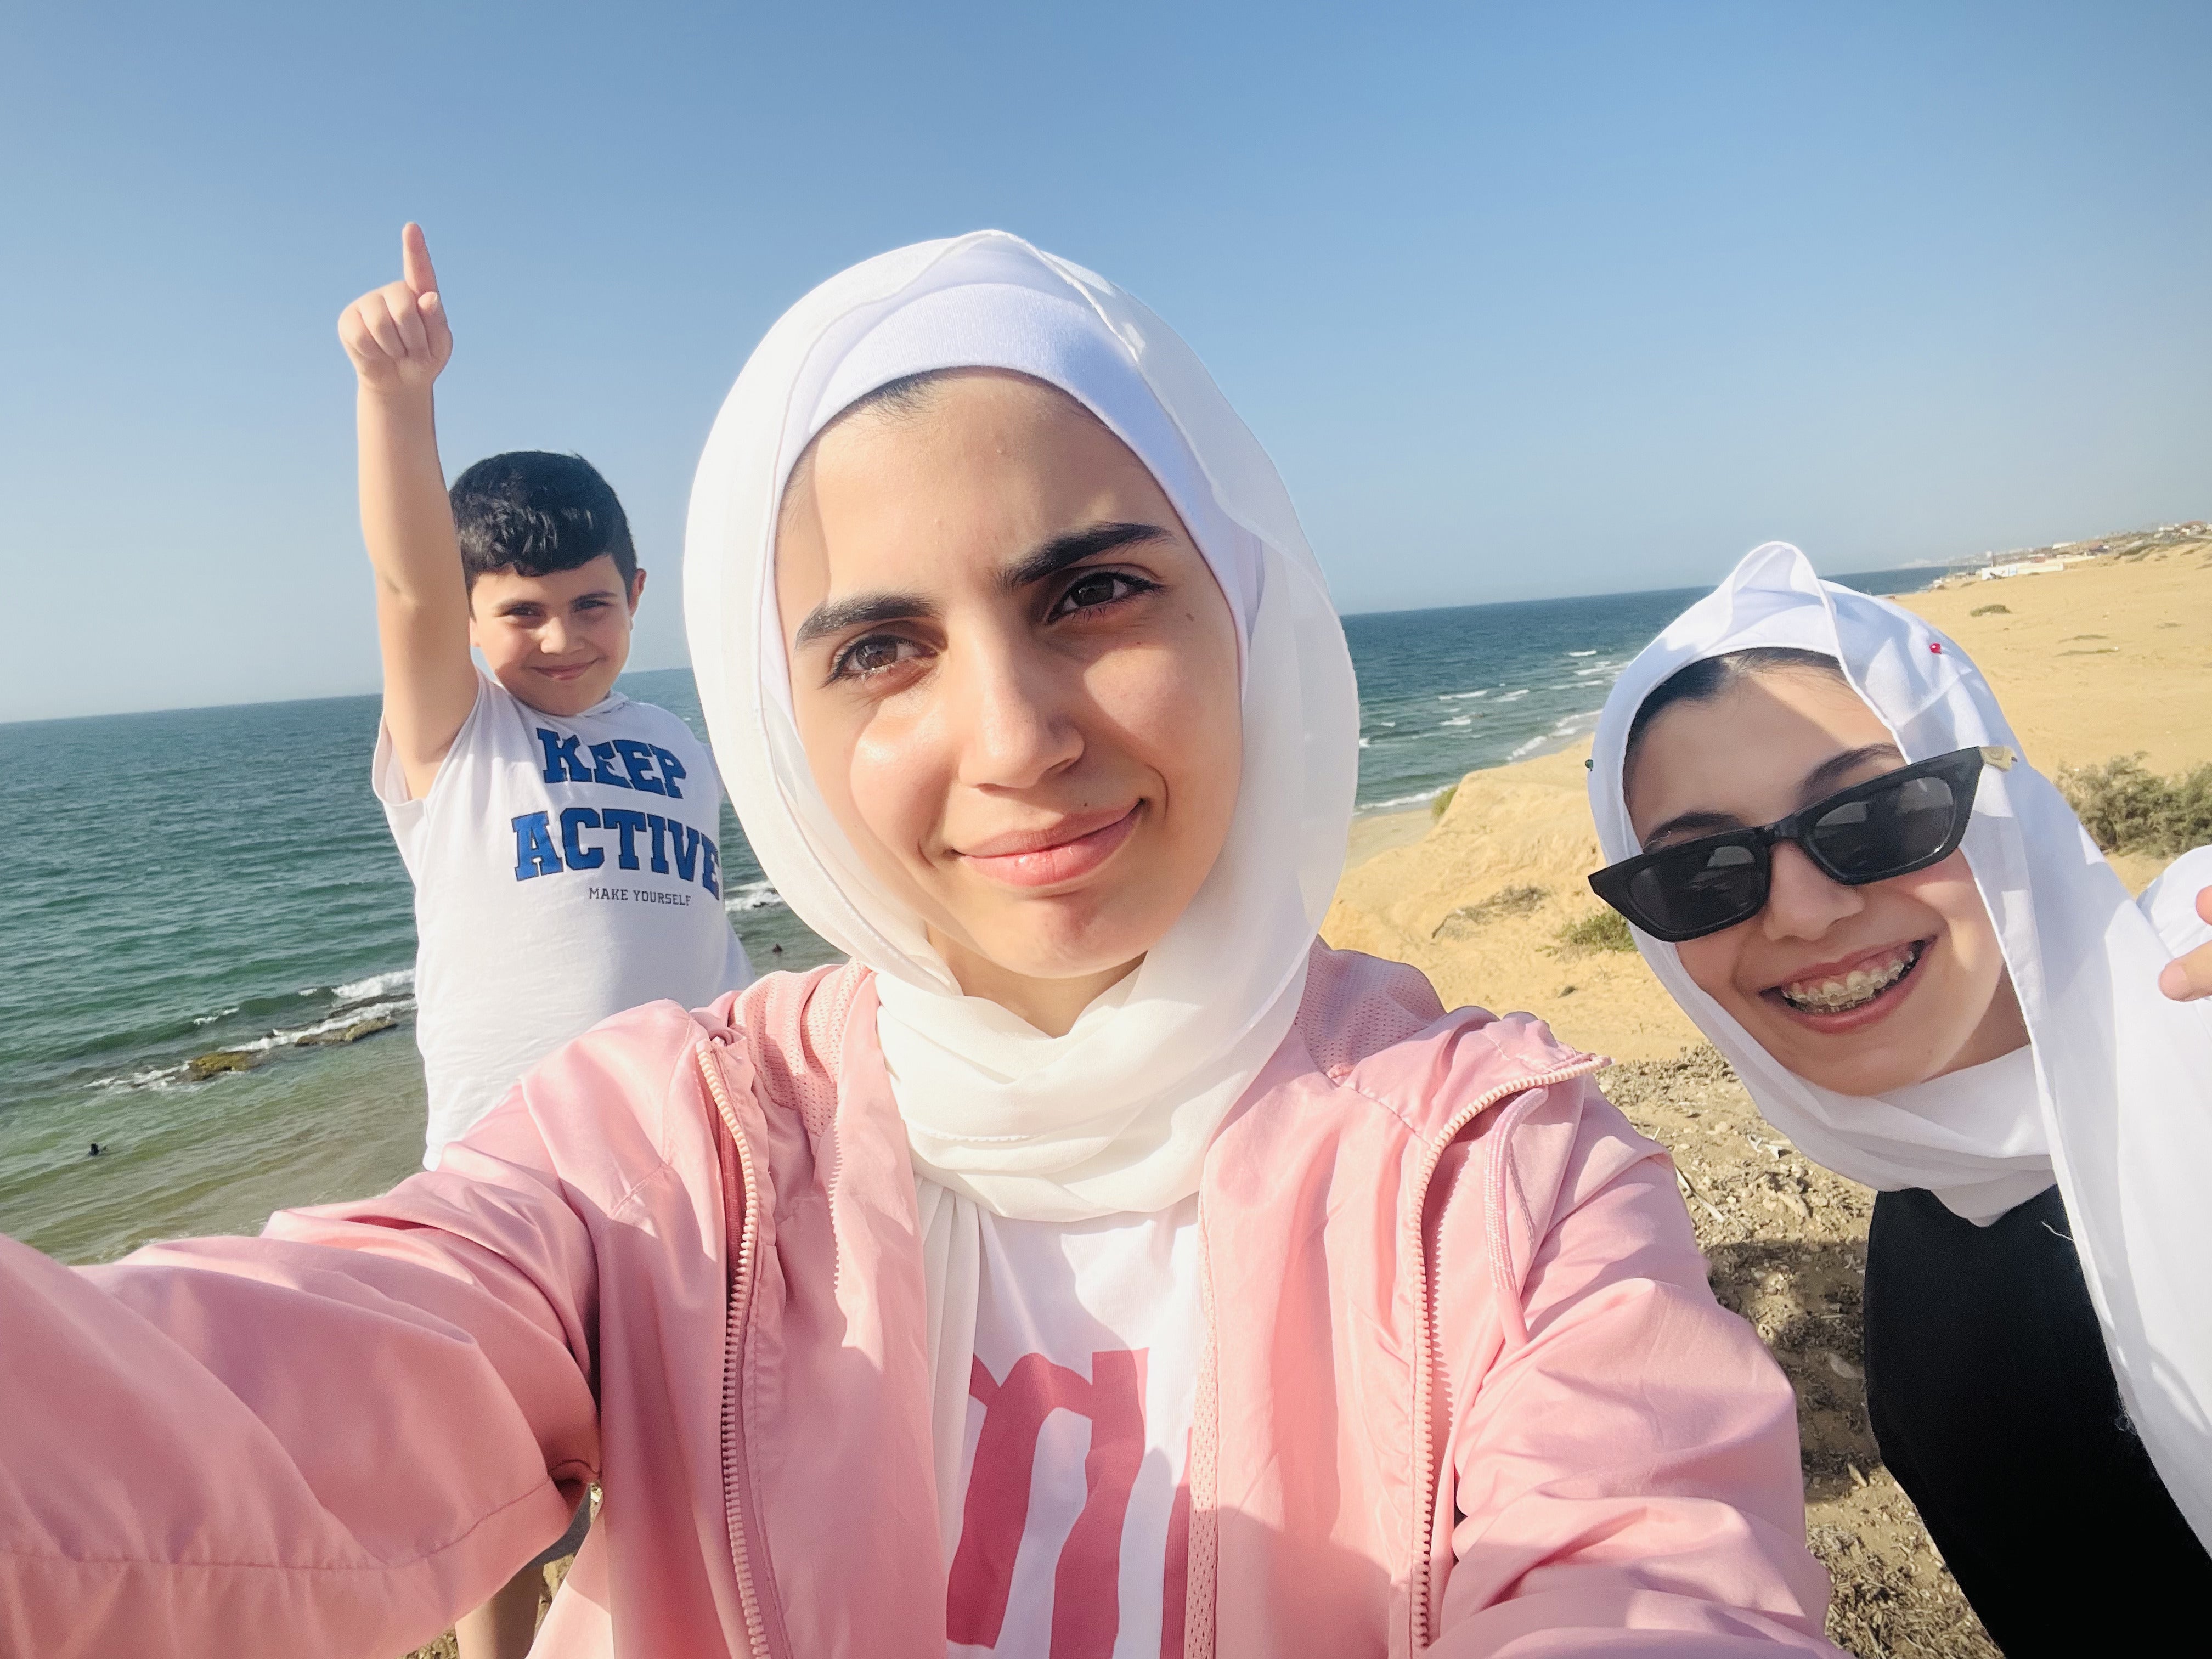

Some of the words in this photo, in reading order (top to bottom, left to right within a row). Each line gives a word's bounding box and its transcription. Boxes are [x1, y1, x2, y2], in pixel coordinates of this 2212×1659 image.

[537, 727, 687, 799] KEEP
[511, 808, 720, 901] ACTIVE
[589, 887, 629, 901] MAKE
[633, 890, 692, 906] YOURSELF
